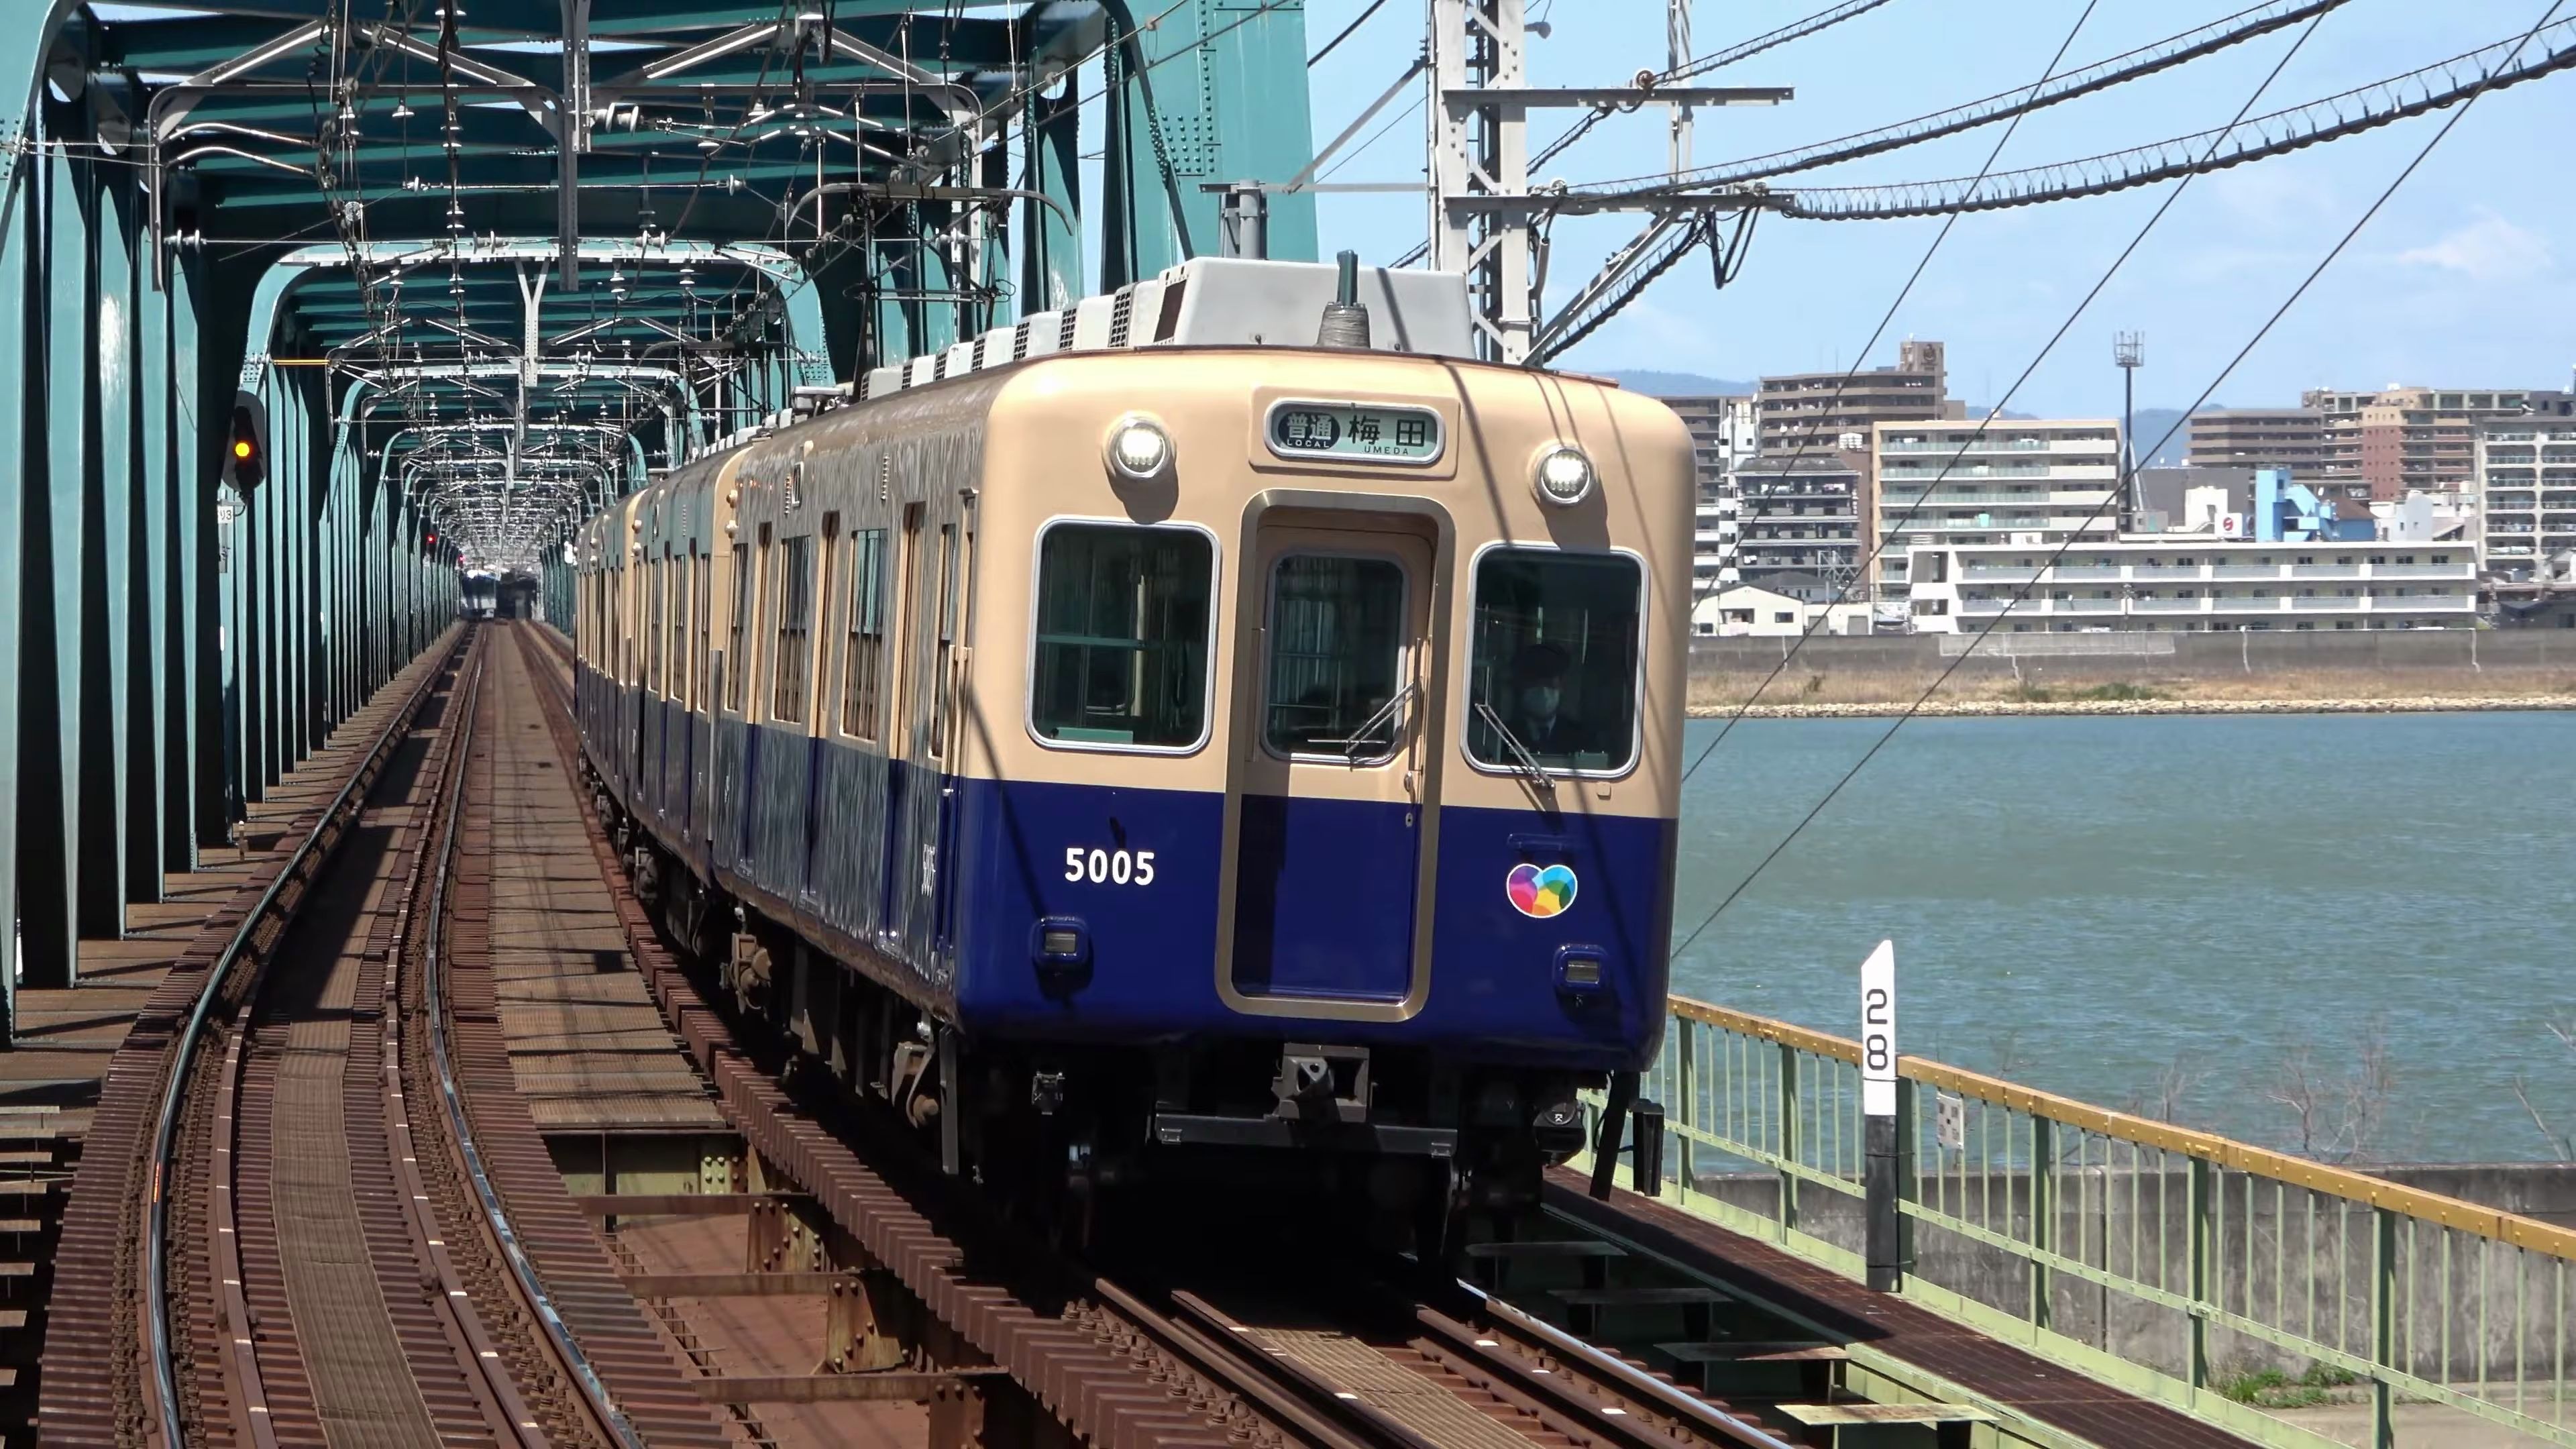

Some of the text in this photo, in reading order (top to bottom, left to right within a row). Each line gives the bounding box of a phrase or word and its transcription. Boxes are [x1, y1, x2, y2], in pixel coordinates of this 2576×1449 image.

[1287, 413, 1332, 440] 普通
[1347, 414, 1426, 447] 梅田
[1287, 438, 1330, 448] LOCAL
[1364, 445, 1409, 455] UMEDA
[1065, 847, 1155, 886] 5005
[1866, 988, 1888, 1071] 28
